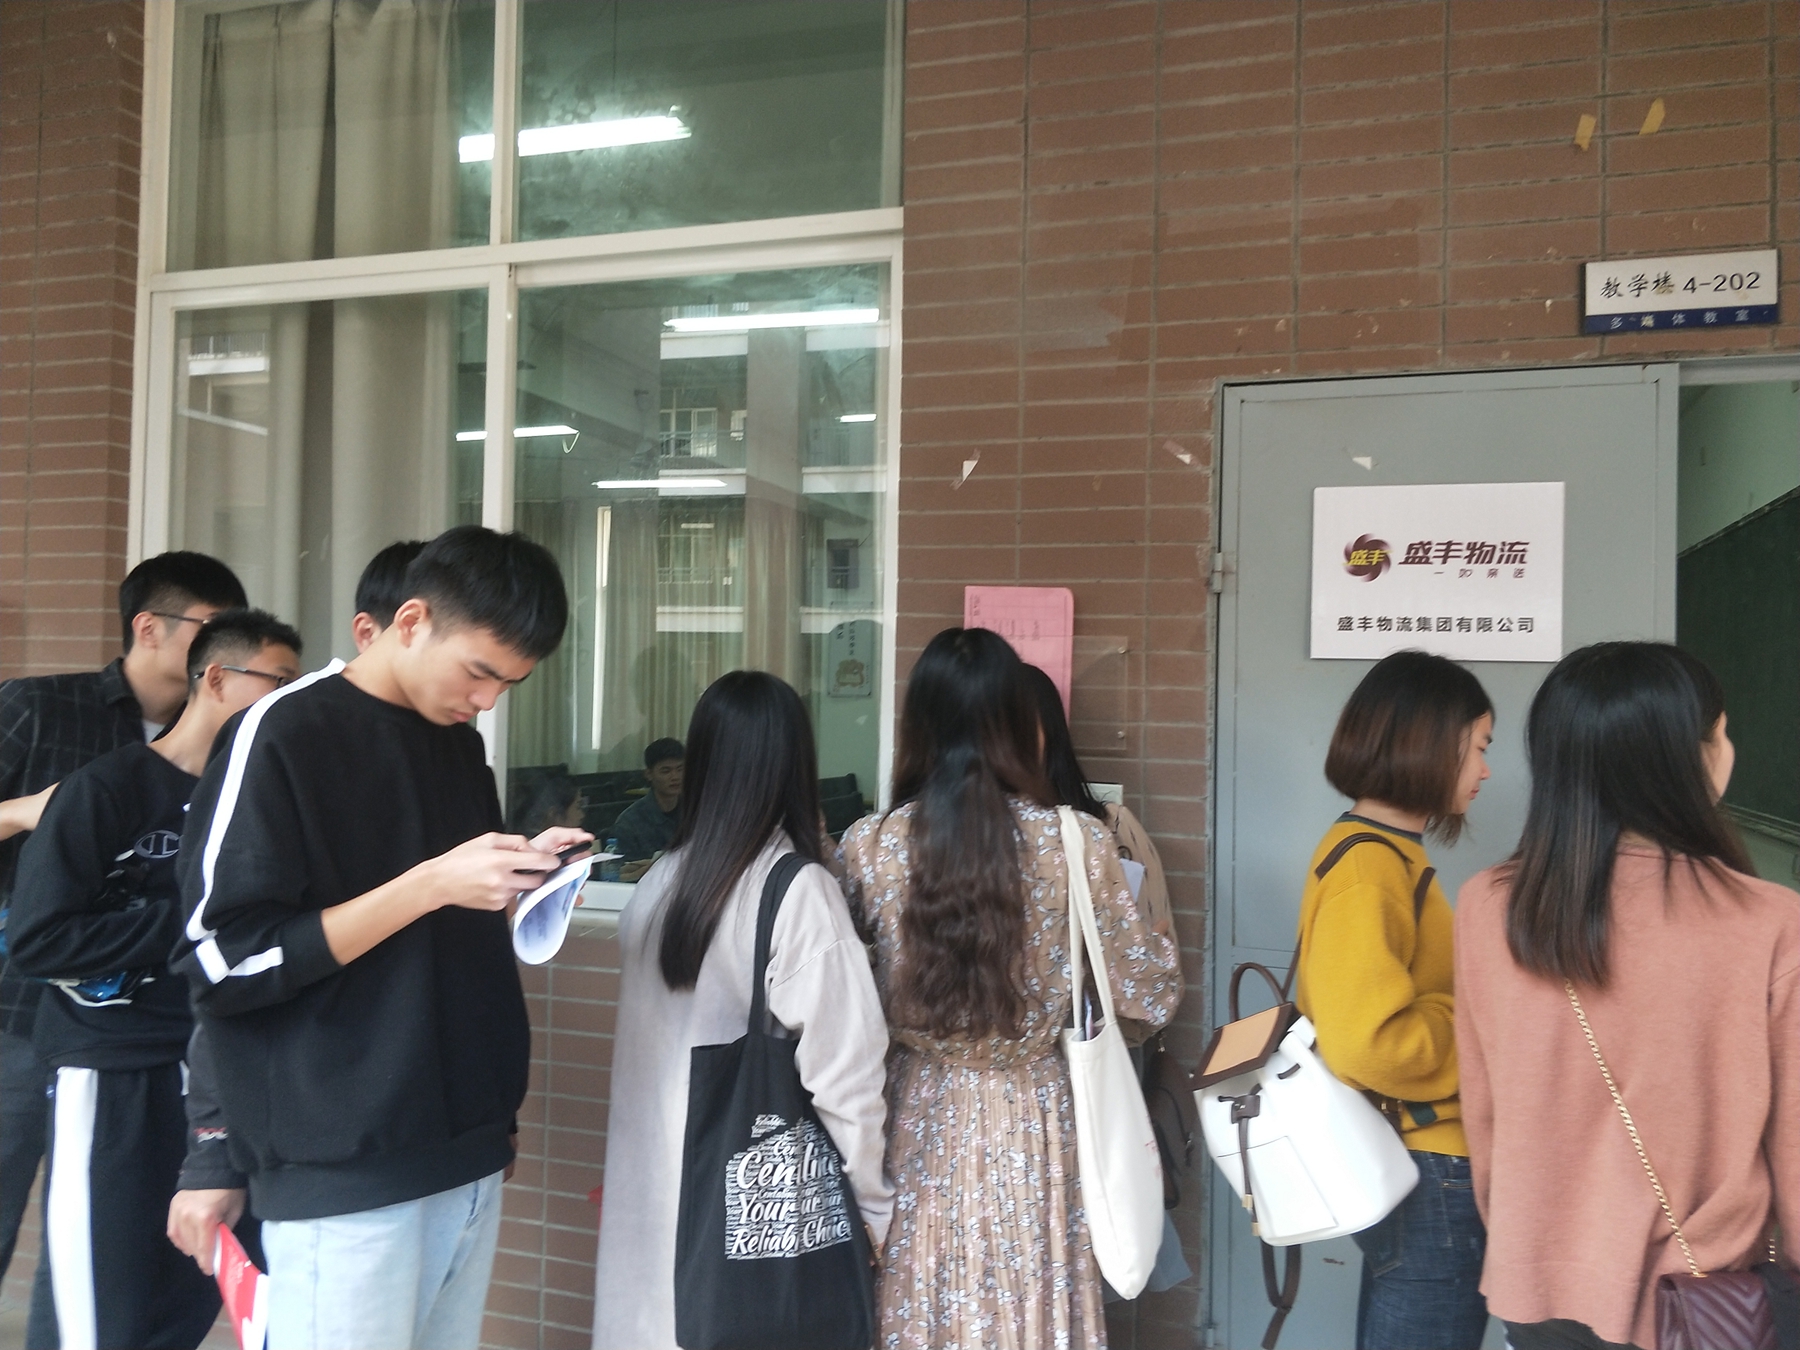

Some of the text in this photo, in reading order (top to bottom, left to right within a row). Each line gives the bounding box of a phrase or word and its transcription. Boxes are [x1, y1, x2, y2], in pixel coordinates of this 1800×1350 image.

[1600, 271, 1761, 299] 教学楼 4-202
[1343, 549, 1393, 567] 盛丰
[1398, 540, 1530, 565] 盛丰物流
[1336, 615, 1535, 633] 盛丰物流集团有限公司
[738, 1193, 797, 1225] Your
